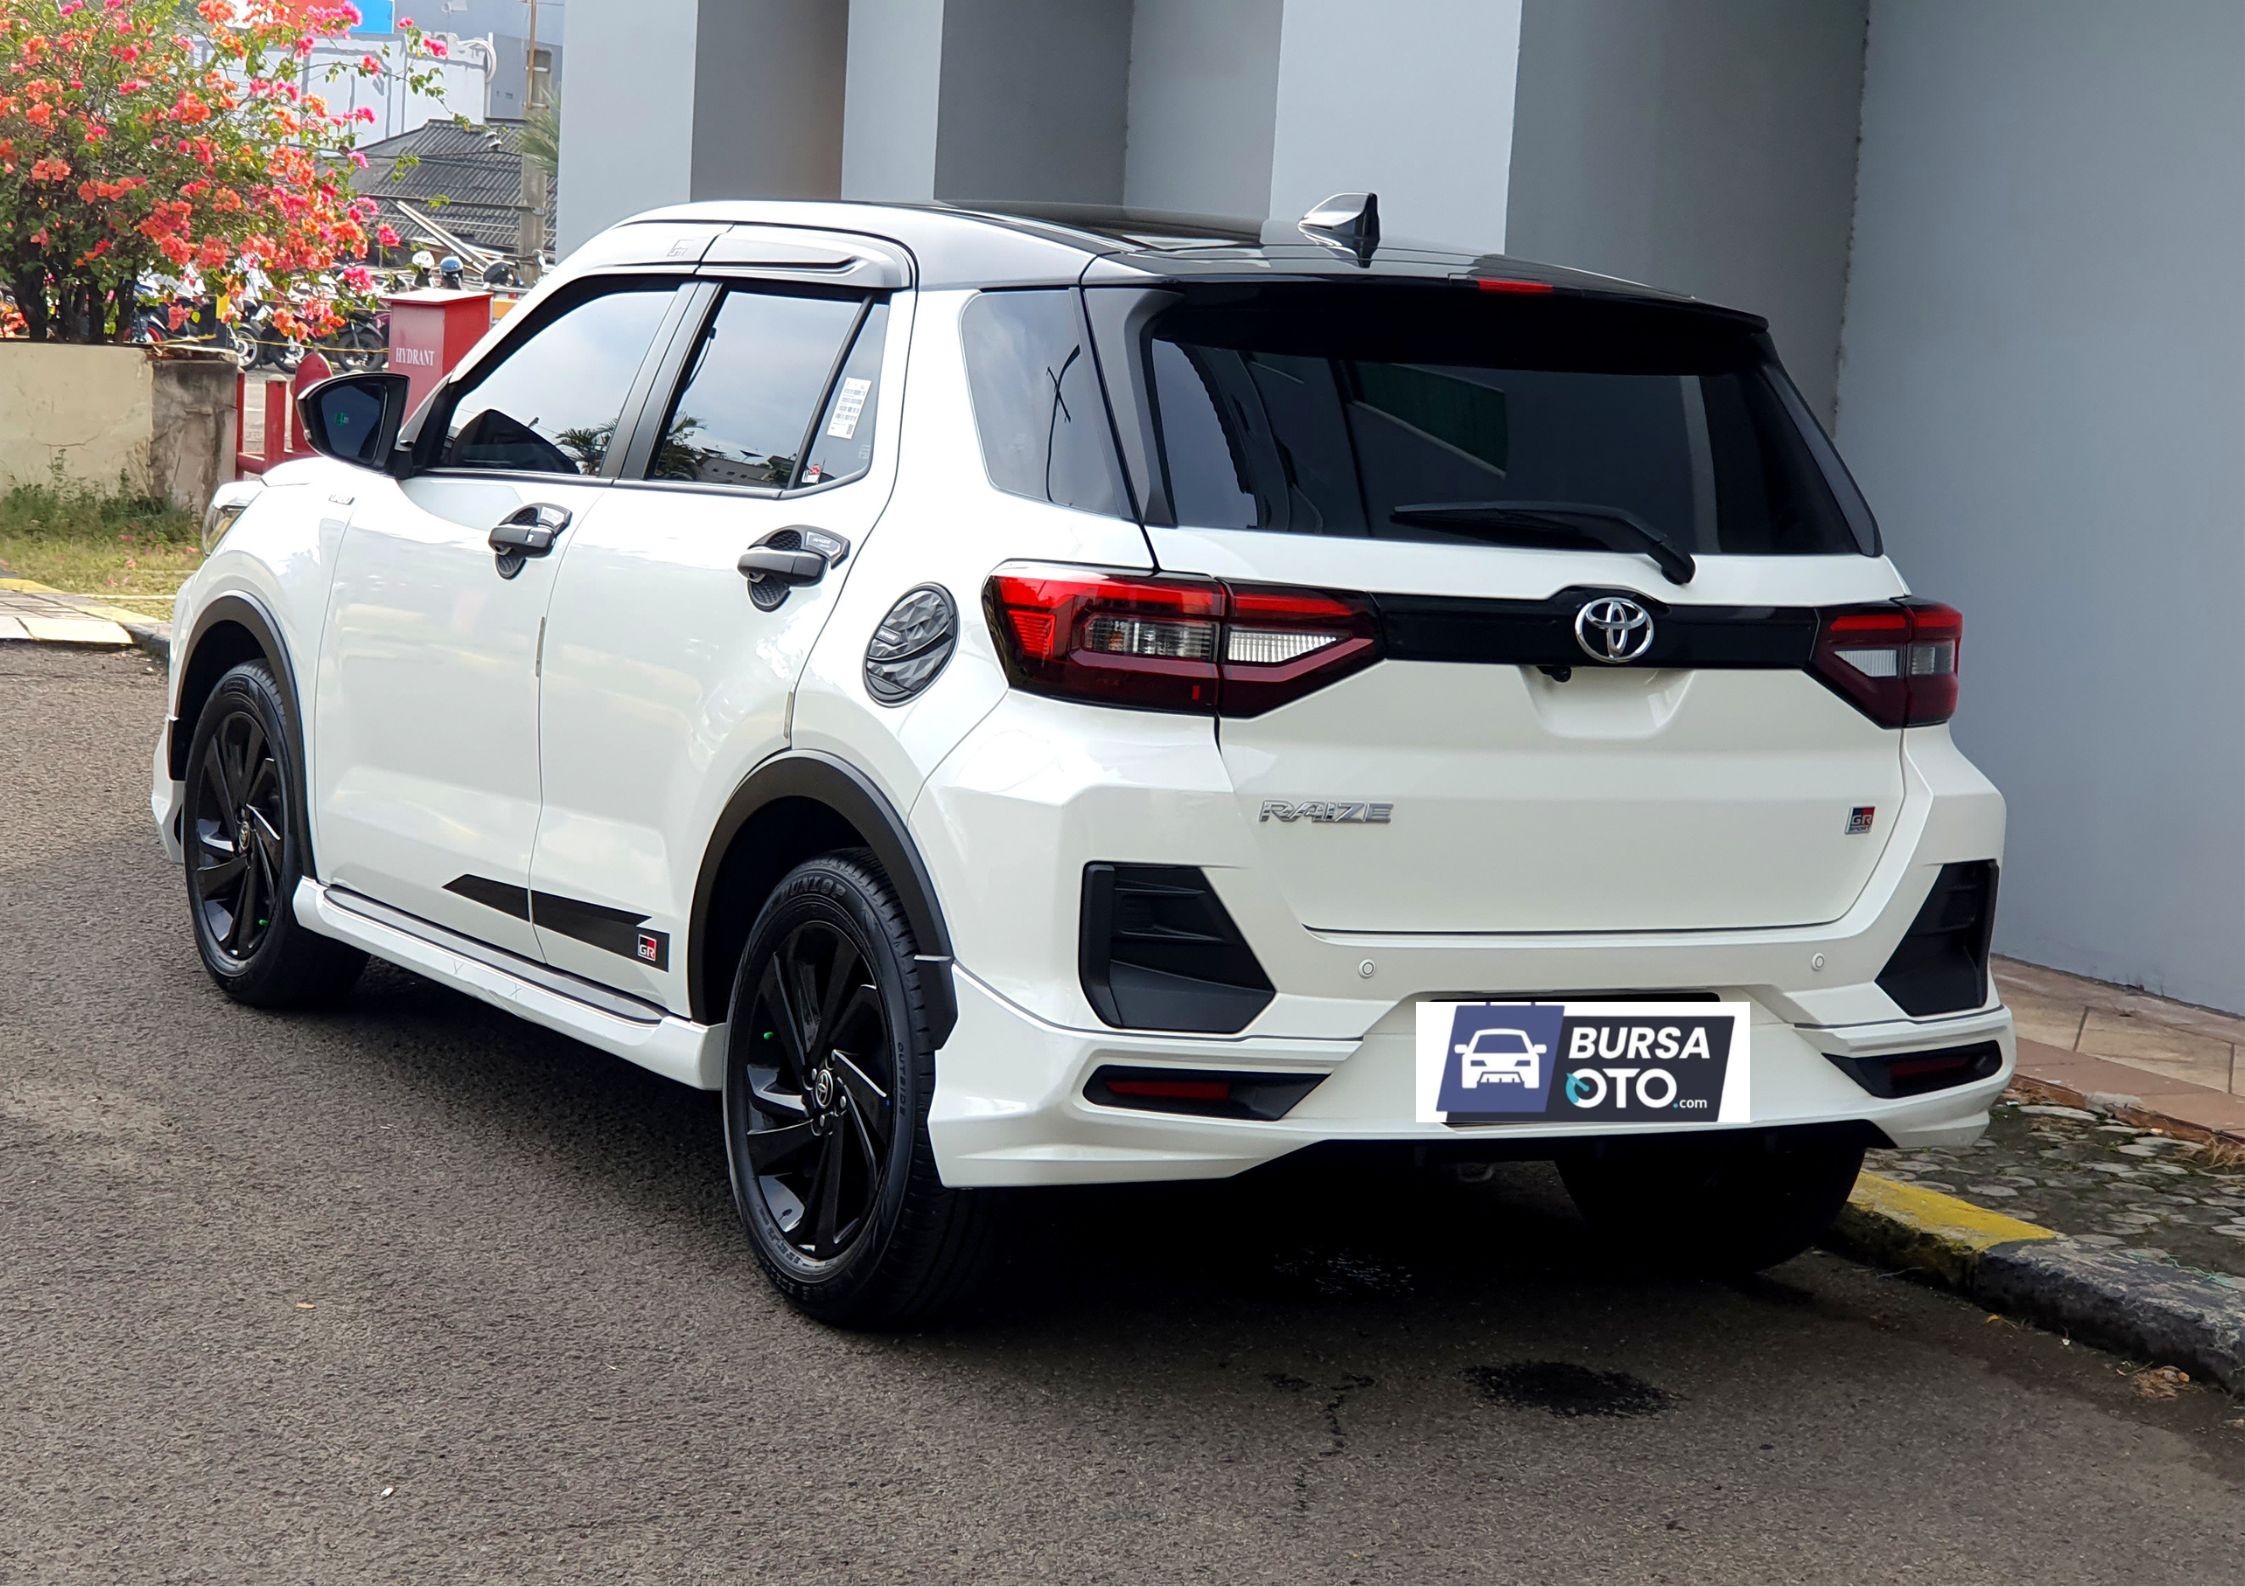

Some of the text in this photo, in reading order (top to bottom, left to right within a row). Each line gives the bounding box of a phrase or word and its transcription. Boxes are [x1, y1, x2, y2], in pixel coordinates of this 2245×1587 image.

[395, 347, 435, 366] HYDRANT
[1259, 800, 1394, 824] RAIZE
[1852, 815, 1873, 825] GR
[640, 944, 656, 959] GR
